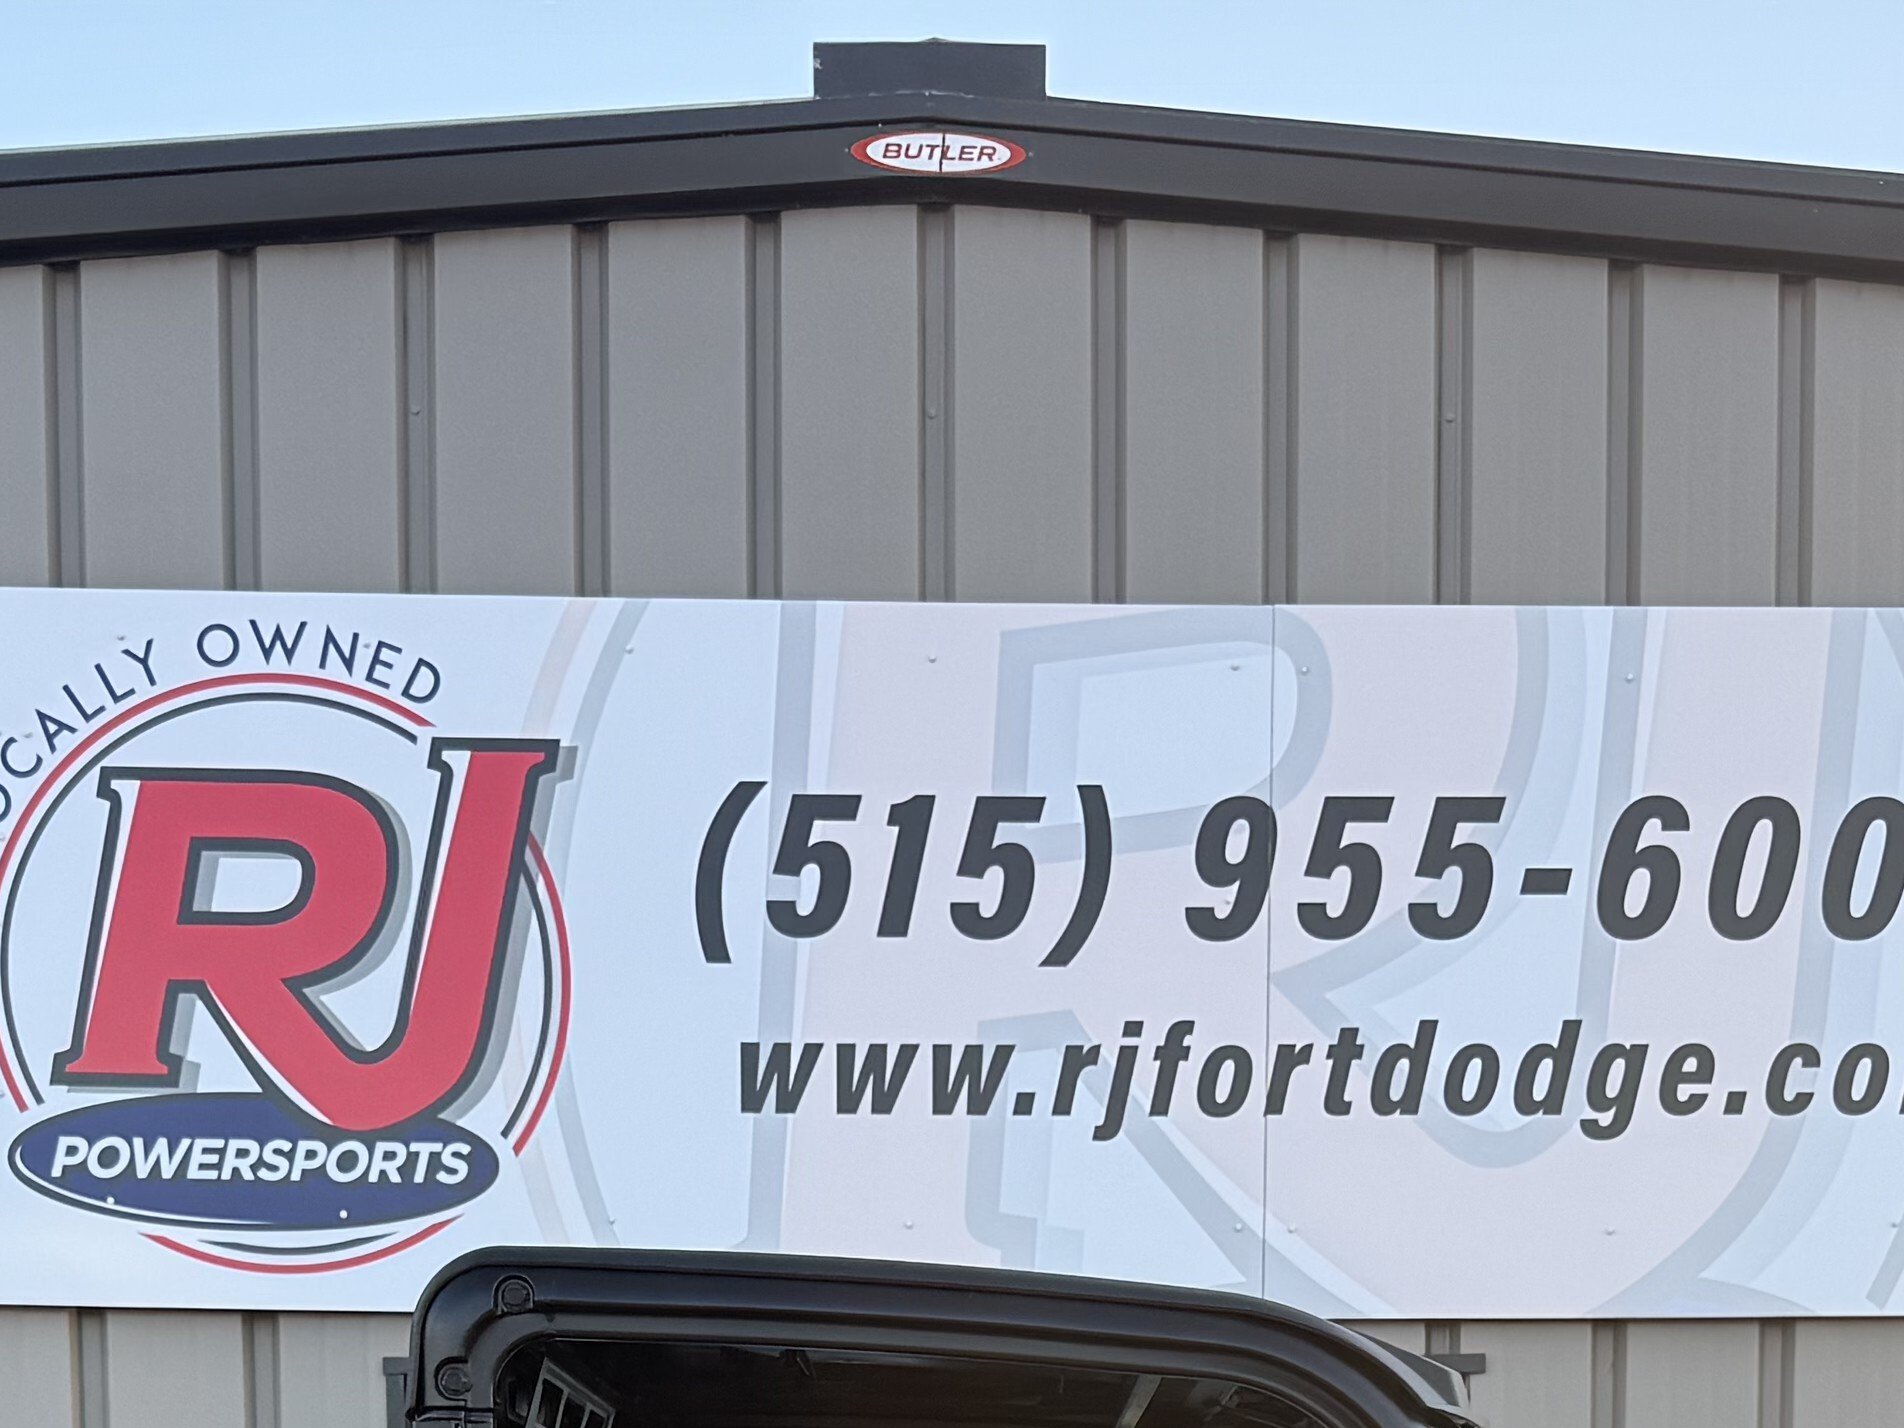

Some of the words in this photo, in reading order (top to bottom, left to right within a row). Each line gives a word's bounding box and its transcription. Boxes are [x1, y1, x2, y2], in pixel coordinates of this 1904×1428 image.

[882, 143, 997, 162] BUTLER
[196, 619, 441, 704] OWNED
[694, 780, 1113, 968] (515)
[50, 737, 564, 1132] RJ
[51, 1136, 471, 1185] POWERSPORTS
